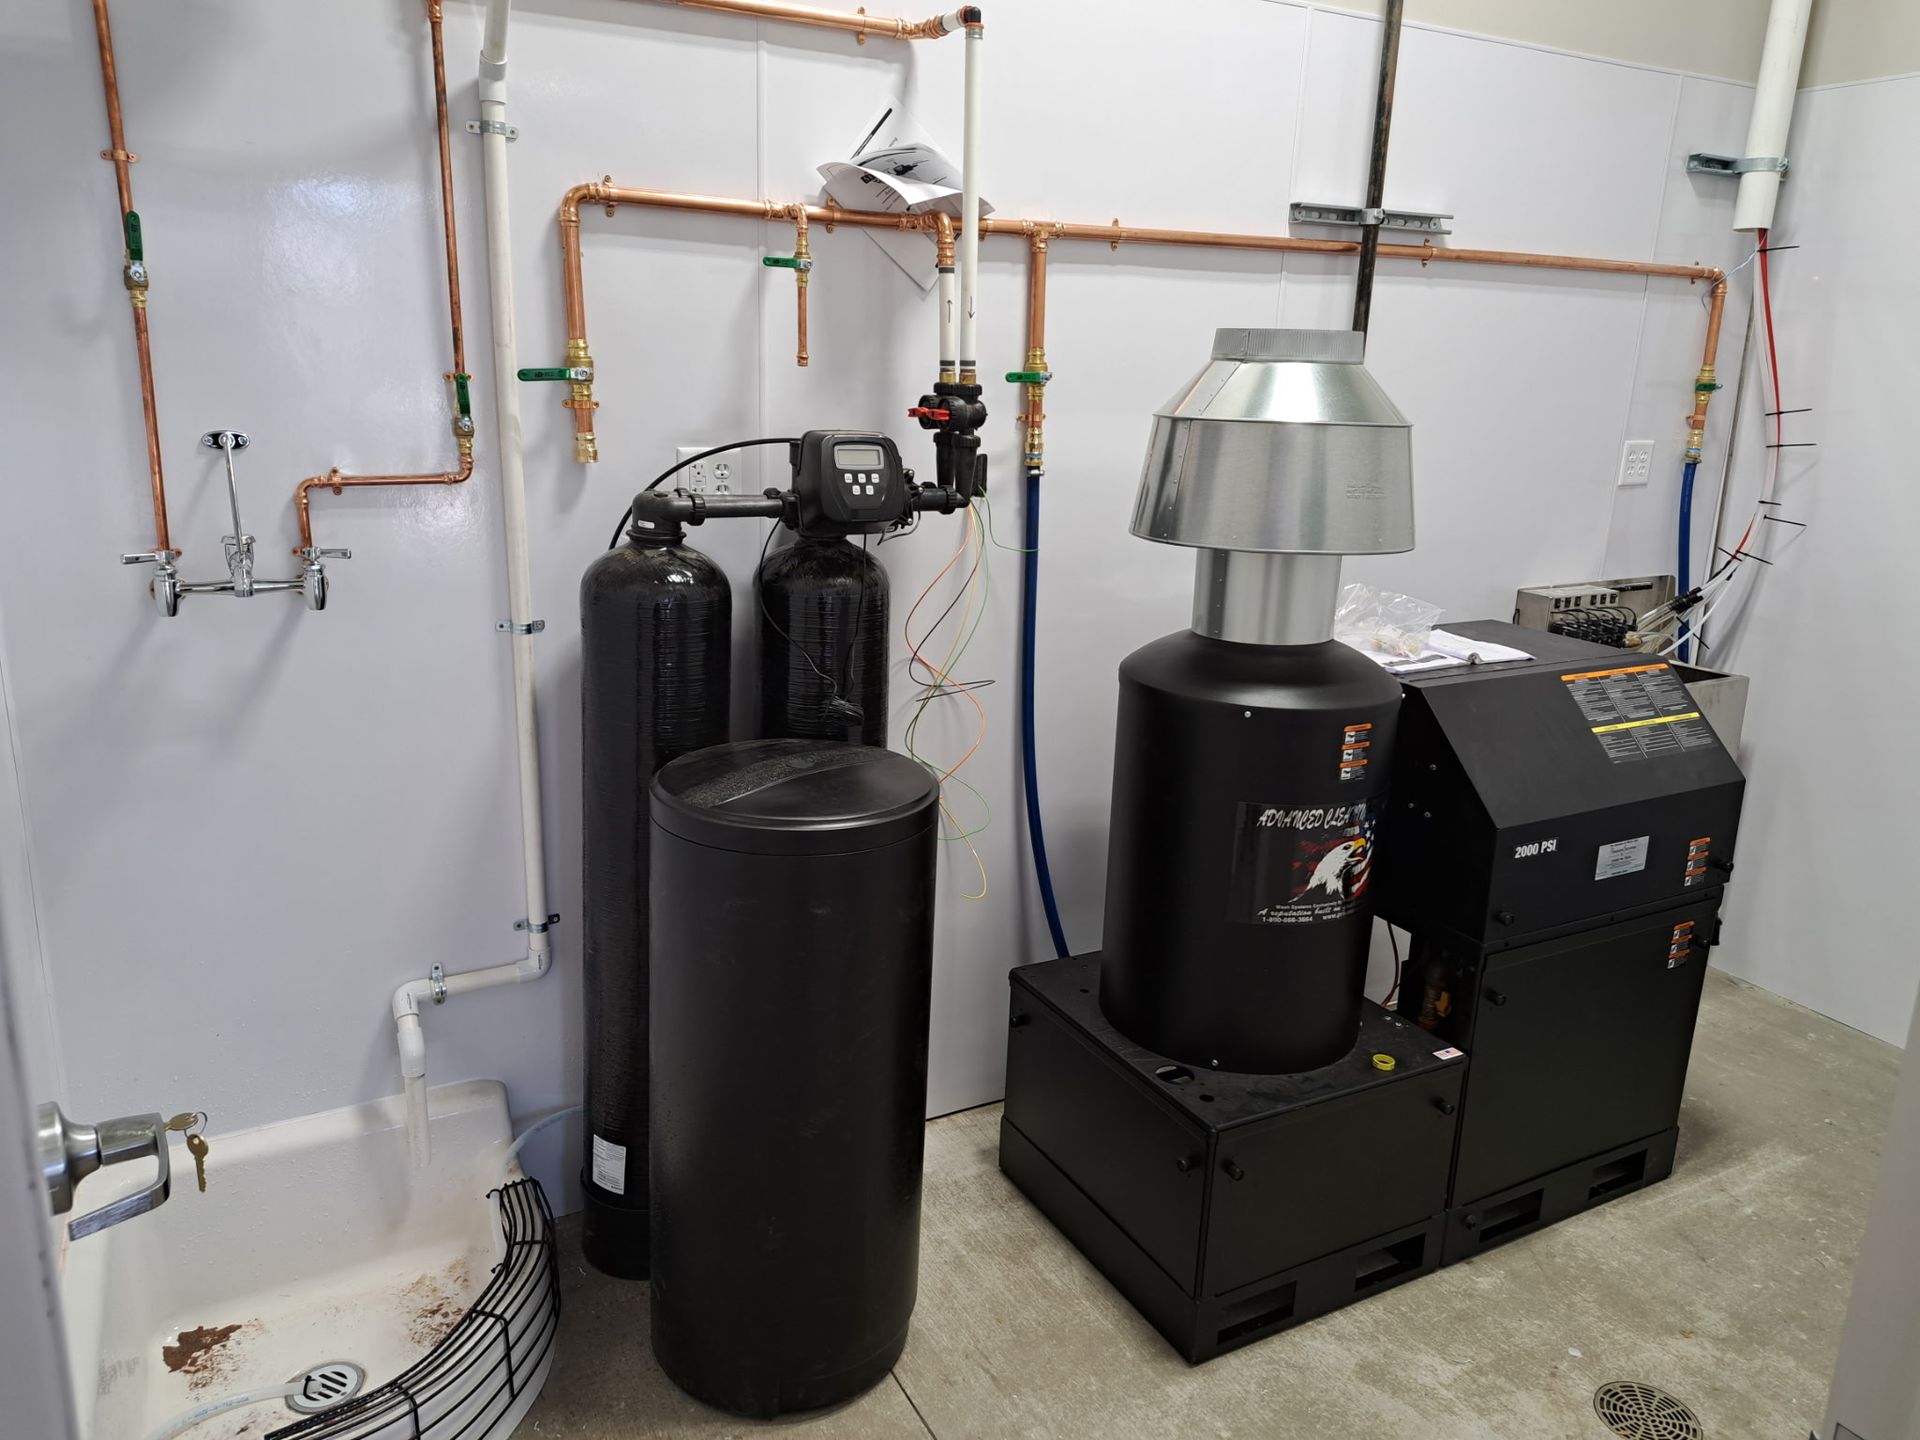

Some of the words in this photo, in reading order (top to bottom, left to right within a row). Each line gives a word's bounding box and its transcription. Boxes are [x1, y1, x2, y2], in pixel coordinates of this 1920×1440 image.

[1256, 808, 1324, 830] ADVANCED
[1514, 843, 1540, 858] 2000
[1541, 839, 1557, 853] PSI
